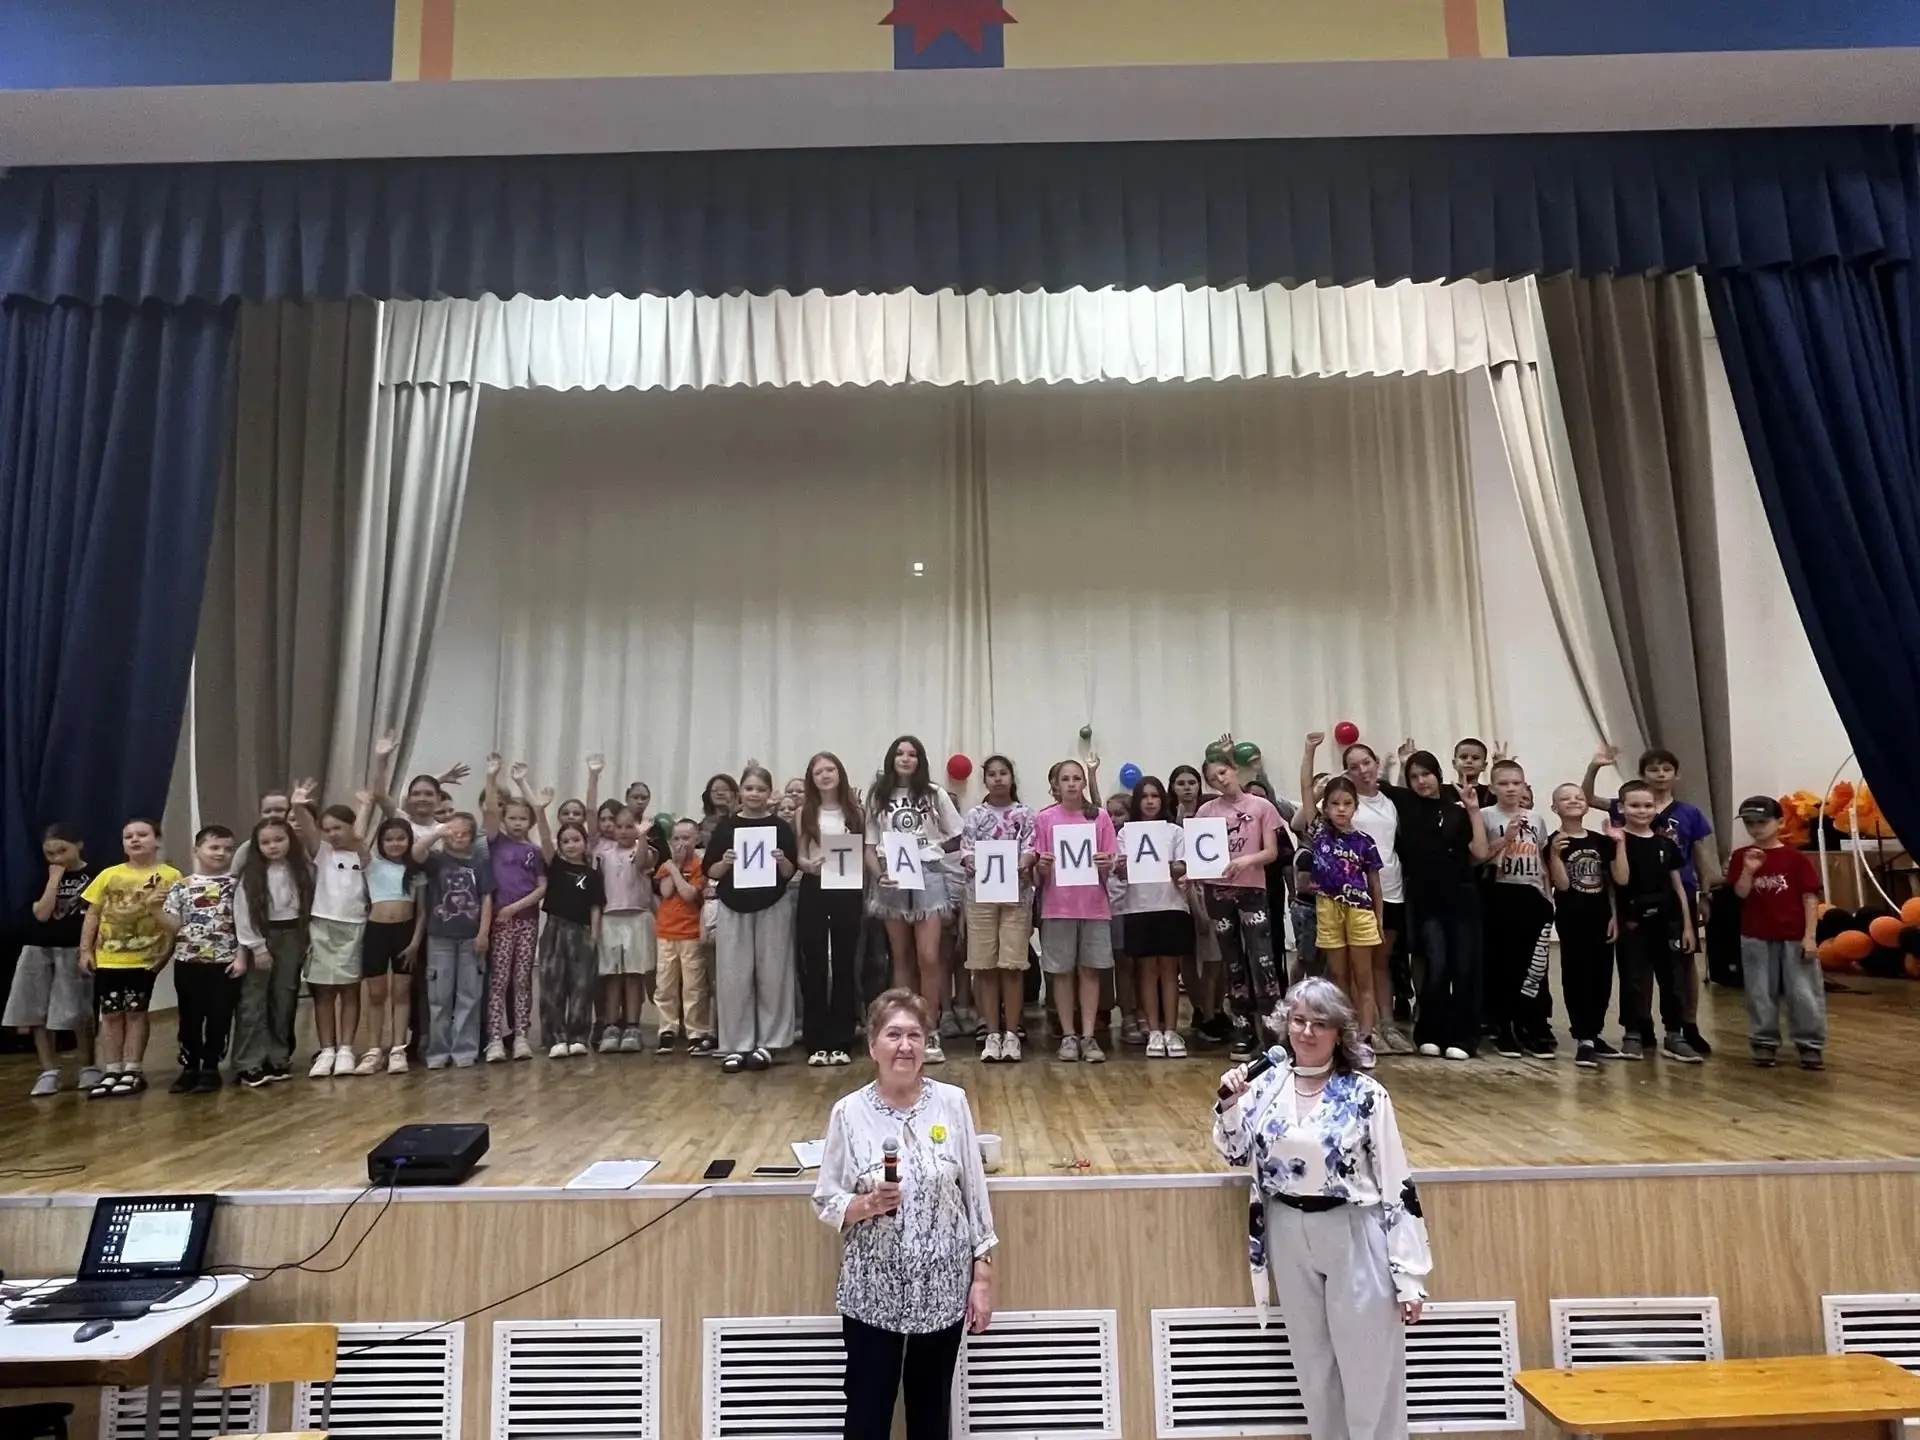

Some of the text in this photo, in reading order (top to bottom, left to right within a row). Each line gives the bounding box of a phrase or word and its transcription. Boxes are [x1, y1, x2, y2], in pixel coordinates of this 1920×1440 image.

[743, 840, 764, 869] И
[832, 848, 852, 876] Т
[896, 846, 916, 874] А
[981, 854, 1005, 884] Л
[1060, 839, 1092, 869] М
[1135, 833, 1160, 863] А
[1195, 833, 1219, 862] С
